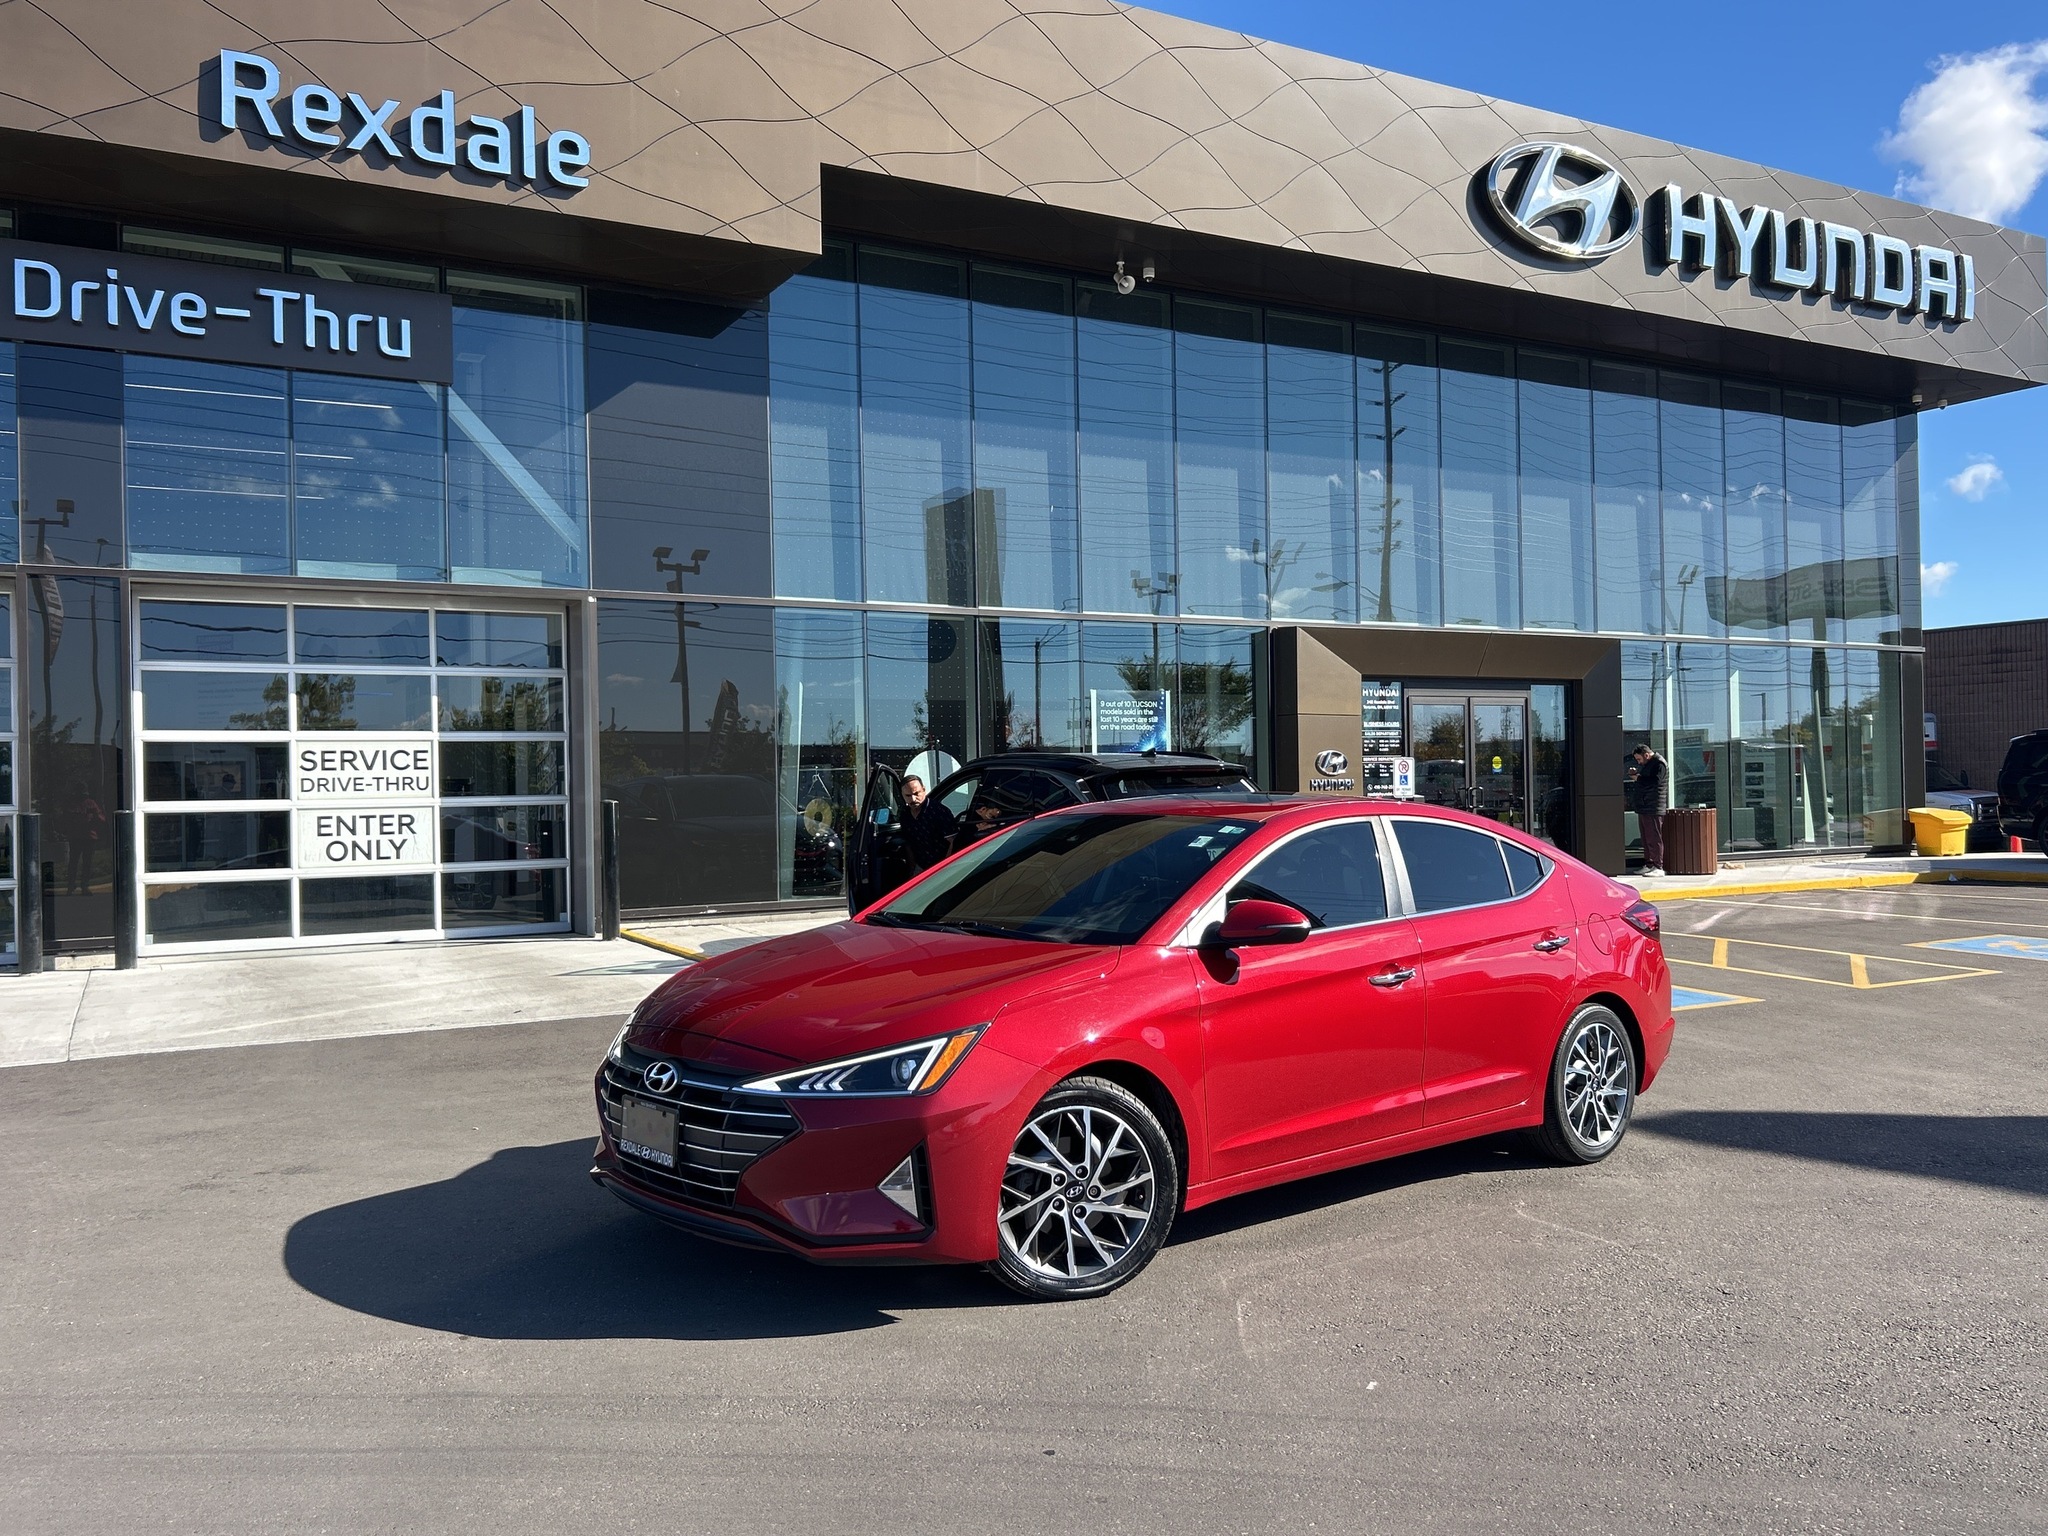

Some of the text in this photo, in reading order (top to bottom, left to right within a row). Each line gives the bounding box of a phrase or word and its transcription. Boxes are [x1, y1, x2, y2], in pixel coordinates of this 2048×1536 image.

[220, 48, 592, 188] Rexdale
[1665, 183, 1975, 322] HYUNDAI
[13, 258, 412, 359] Drive-Thru
[1362, 689, 1399, 697] HYUNDAI
[299, 749, 429, 771] SERVICE
[300, 776, 429, 793] DRIVE-THRU
[317, 814, 417, 837] ENTER
[325, 838, 408, 862] ONLY
[651, 1148, 674, 1168] HYUNDAI
